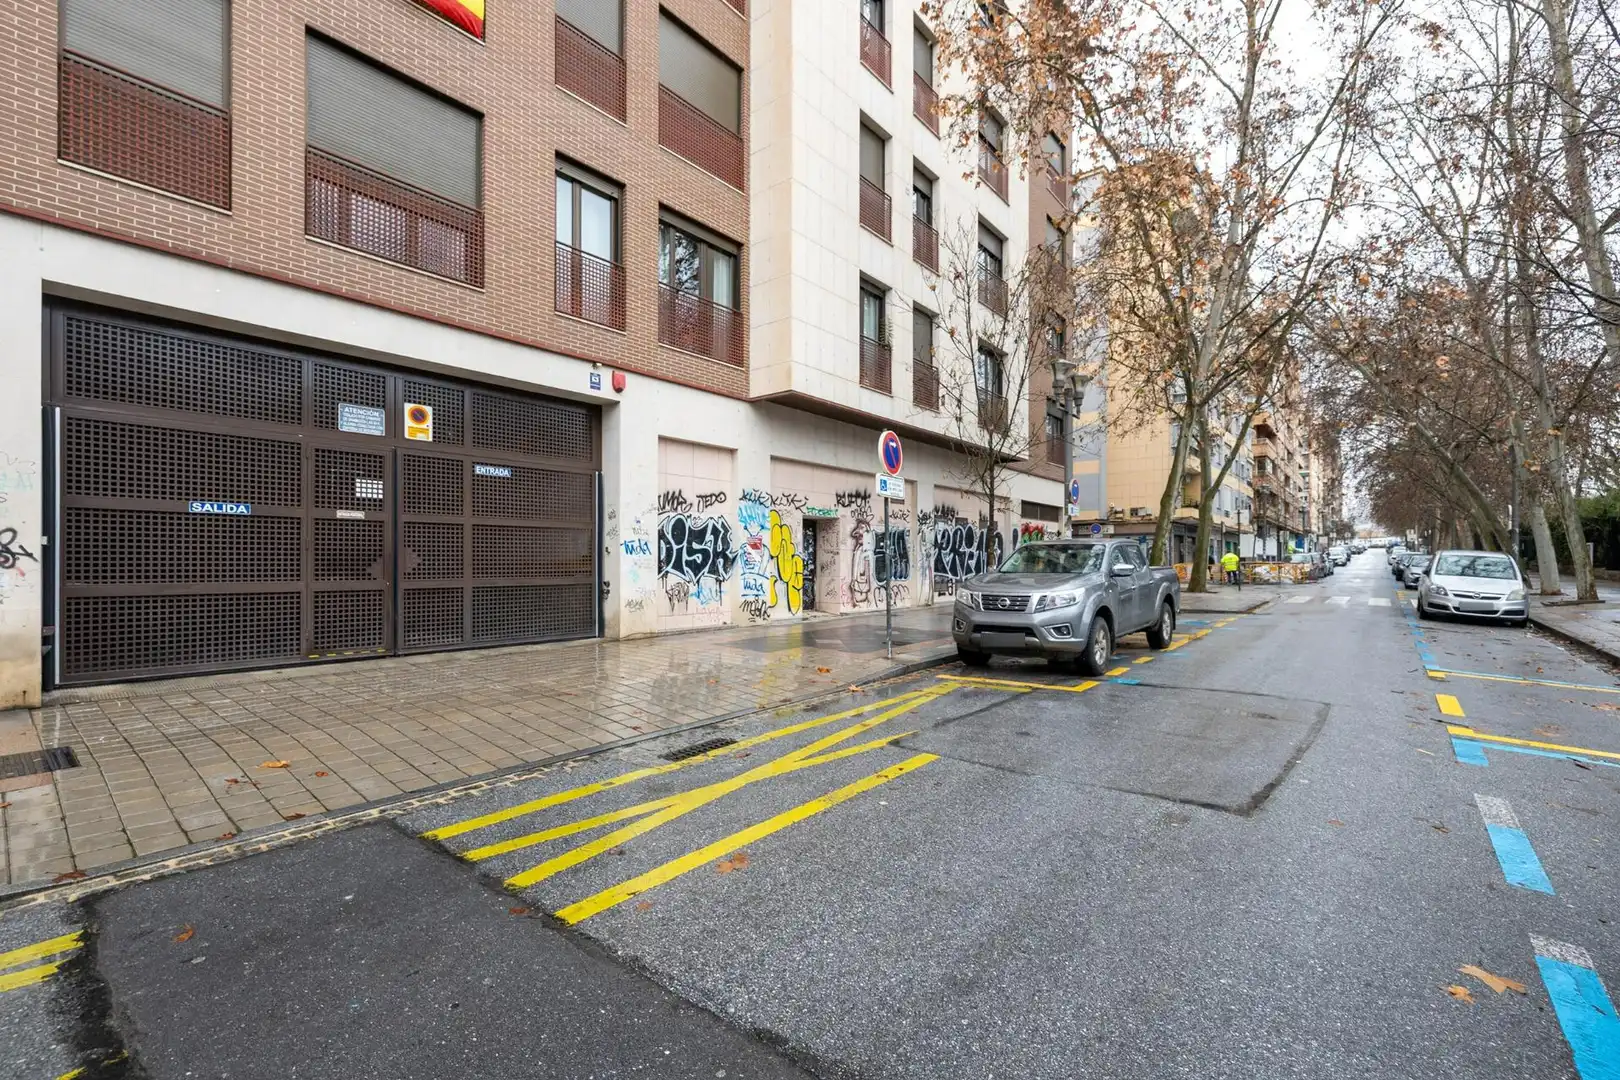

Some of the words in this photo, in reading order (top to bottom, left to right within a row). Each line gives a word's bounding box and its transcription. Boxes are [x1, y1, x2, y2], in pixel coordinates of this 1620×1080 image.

[344, 406, 380, 417] ATENCIÓN
[476, 466, 511, 477] ENTRADA
[191, 502, 248, 514] SALIDA
